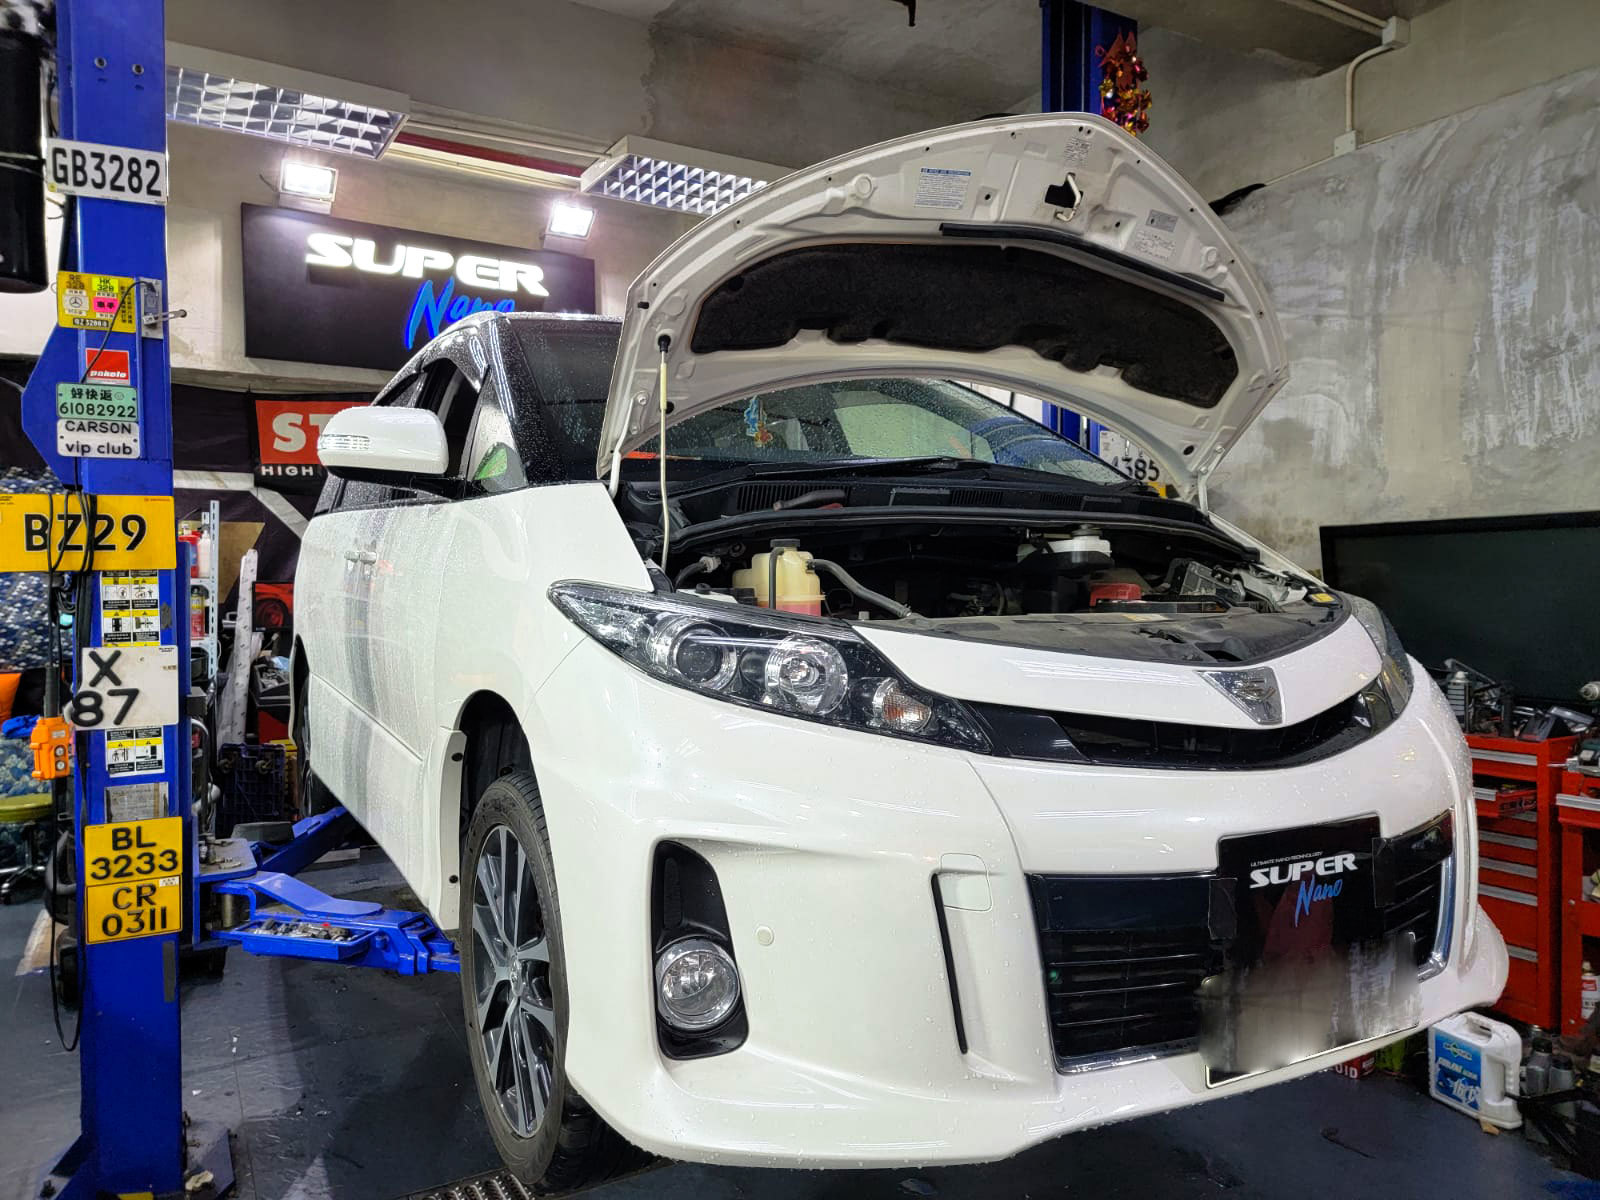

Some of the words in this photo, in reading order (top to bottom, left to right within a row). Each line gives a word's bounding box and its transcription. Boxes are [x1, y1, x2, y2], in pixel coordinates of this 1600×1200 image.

[52, 147, 162, 197] GB3282
[306, 232, 549, 297] SUPER
[60, 402, 136, 418] 61082922
[65, 420, 132, 434] CARSON
[65, 441, 91, 456] vip
[97, 442, 132, 455] club
[261, 466, 313, 476] HIGH
[88, 650, 122, 687] X
[70, 688, 140, 727] 87
[112, 826, 157, 851] BL
[90, 849, 178, 880] 3233
[1249, 853, 1358, 889] SUPER
[112, 883, 157, 910] CR
[1295, 874, 1343, 928] Nano
[102, 906, 167, 937] 0311
